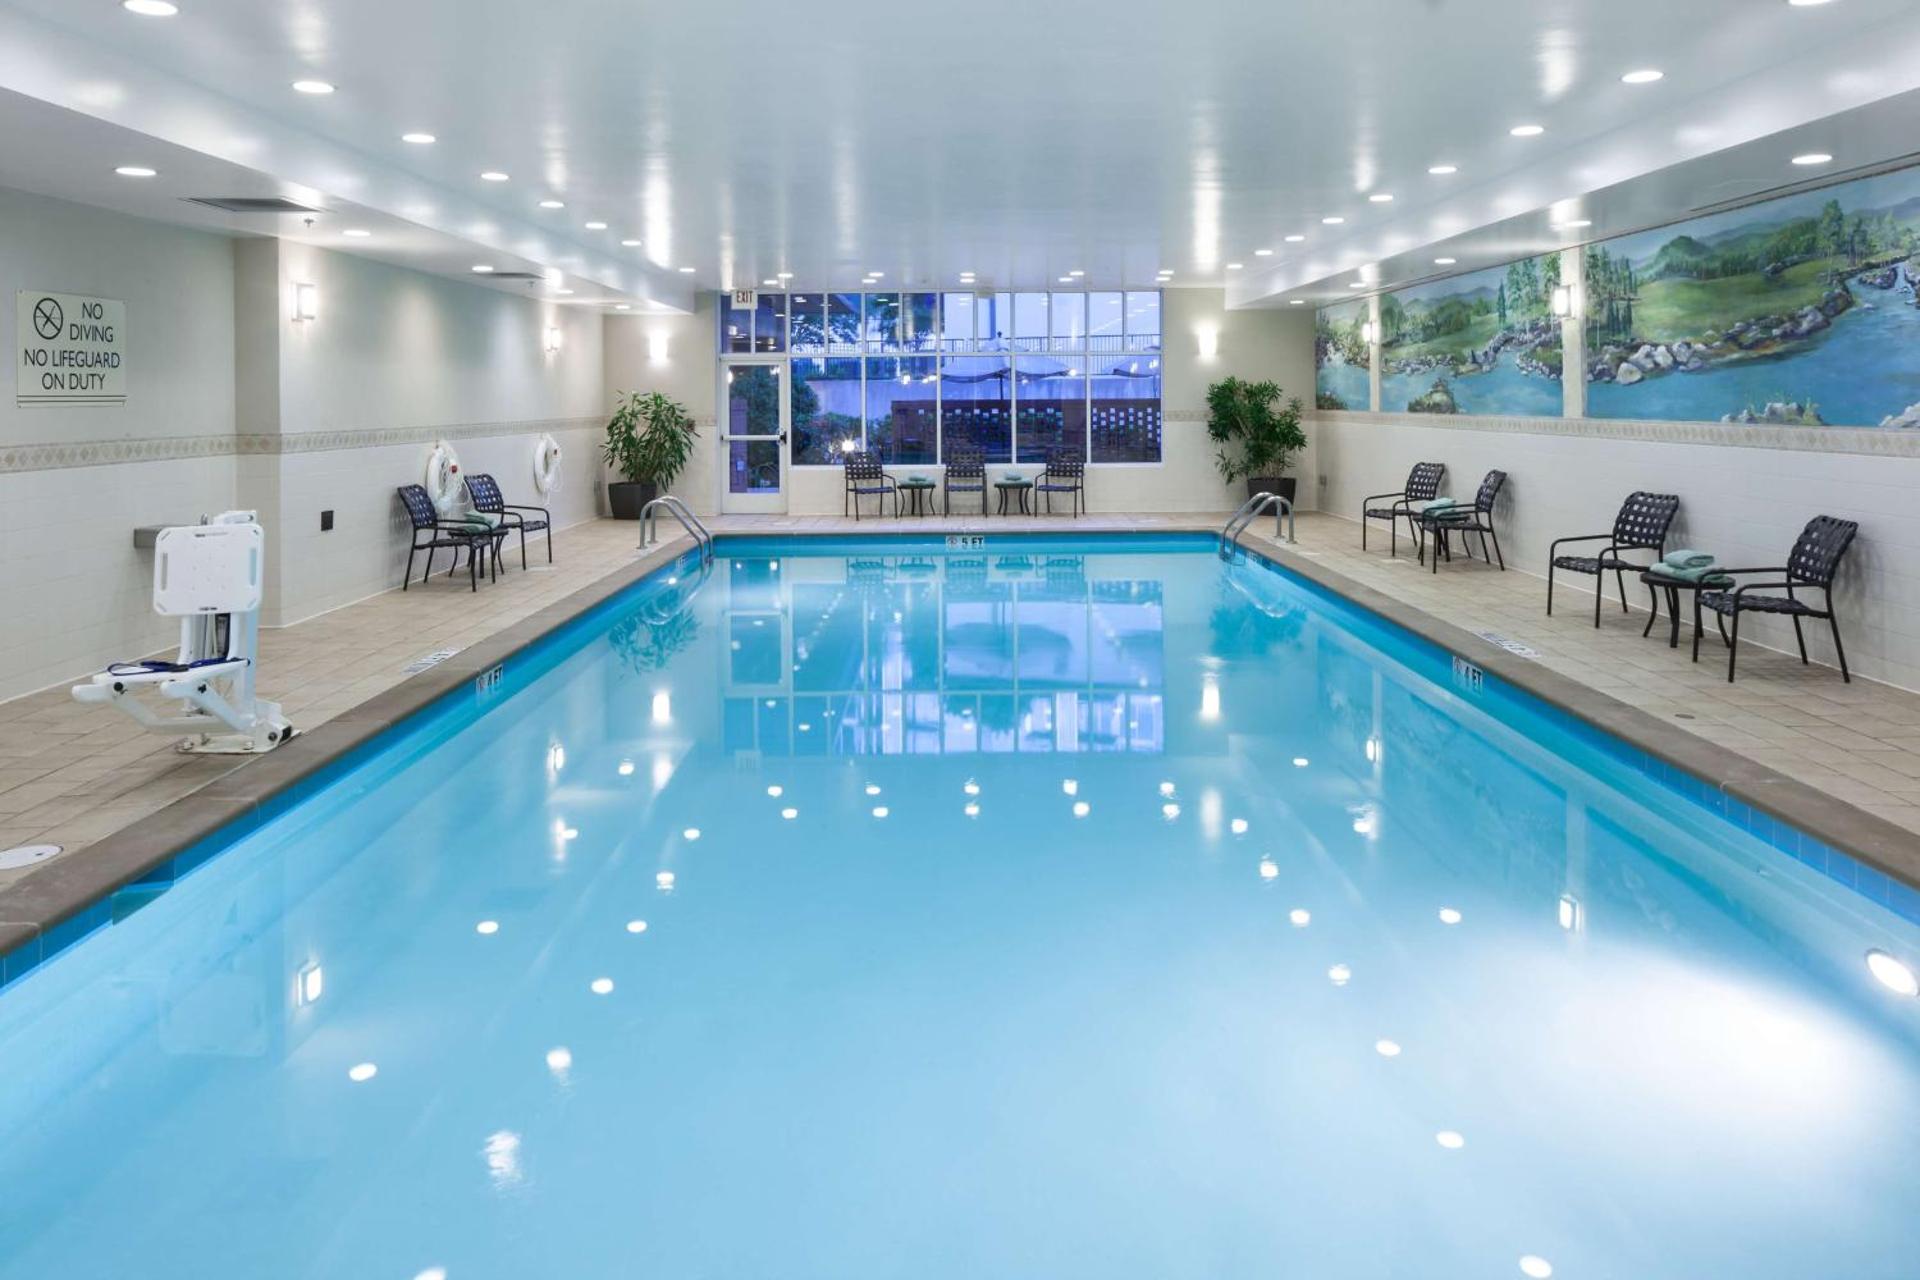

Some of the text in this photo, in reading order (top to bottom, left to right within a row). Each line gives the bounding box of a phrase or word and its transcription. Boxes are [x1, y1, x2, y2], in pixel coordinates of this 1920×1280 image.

[736, 290, 753, 304] EXIT
[82, 302, 104, 320] NO
[69, 323, 114, 343] DIVING
[24, 348, 121, 369] NO LIFEGUARD
[41, 372, 105, 390] ON DUTY
[961, 537, 984, 547] 5 FT
[1471, 668, 1482, 684] FT
